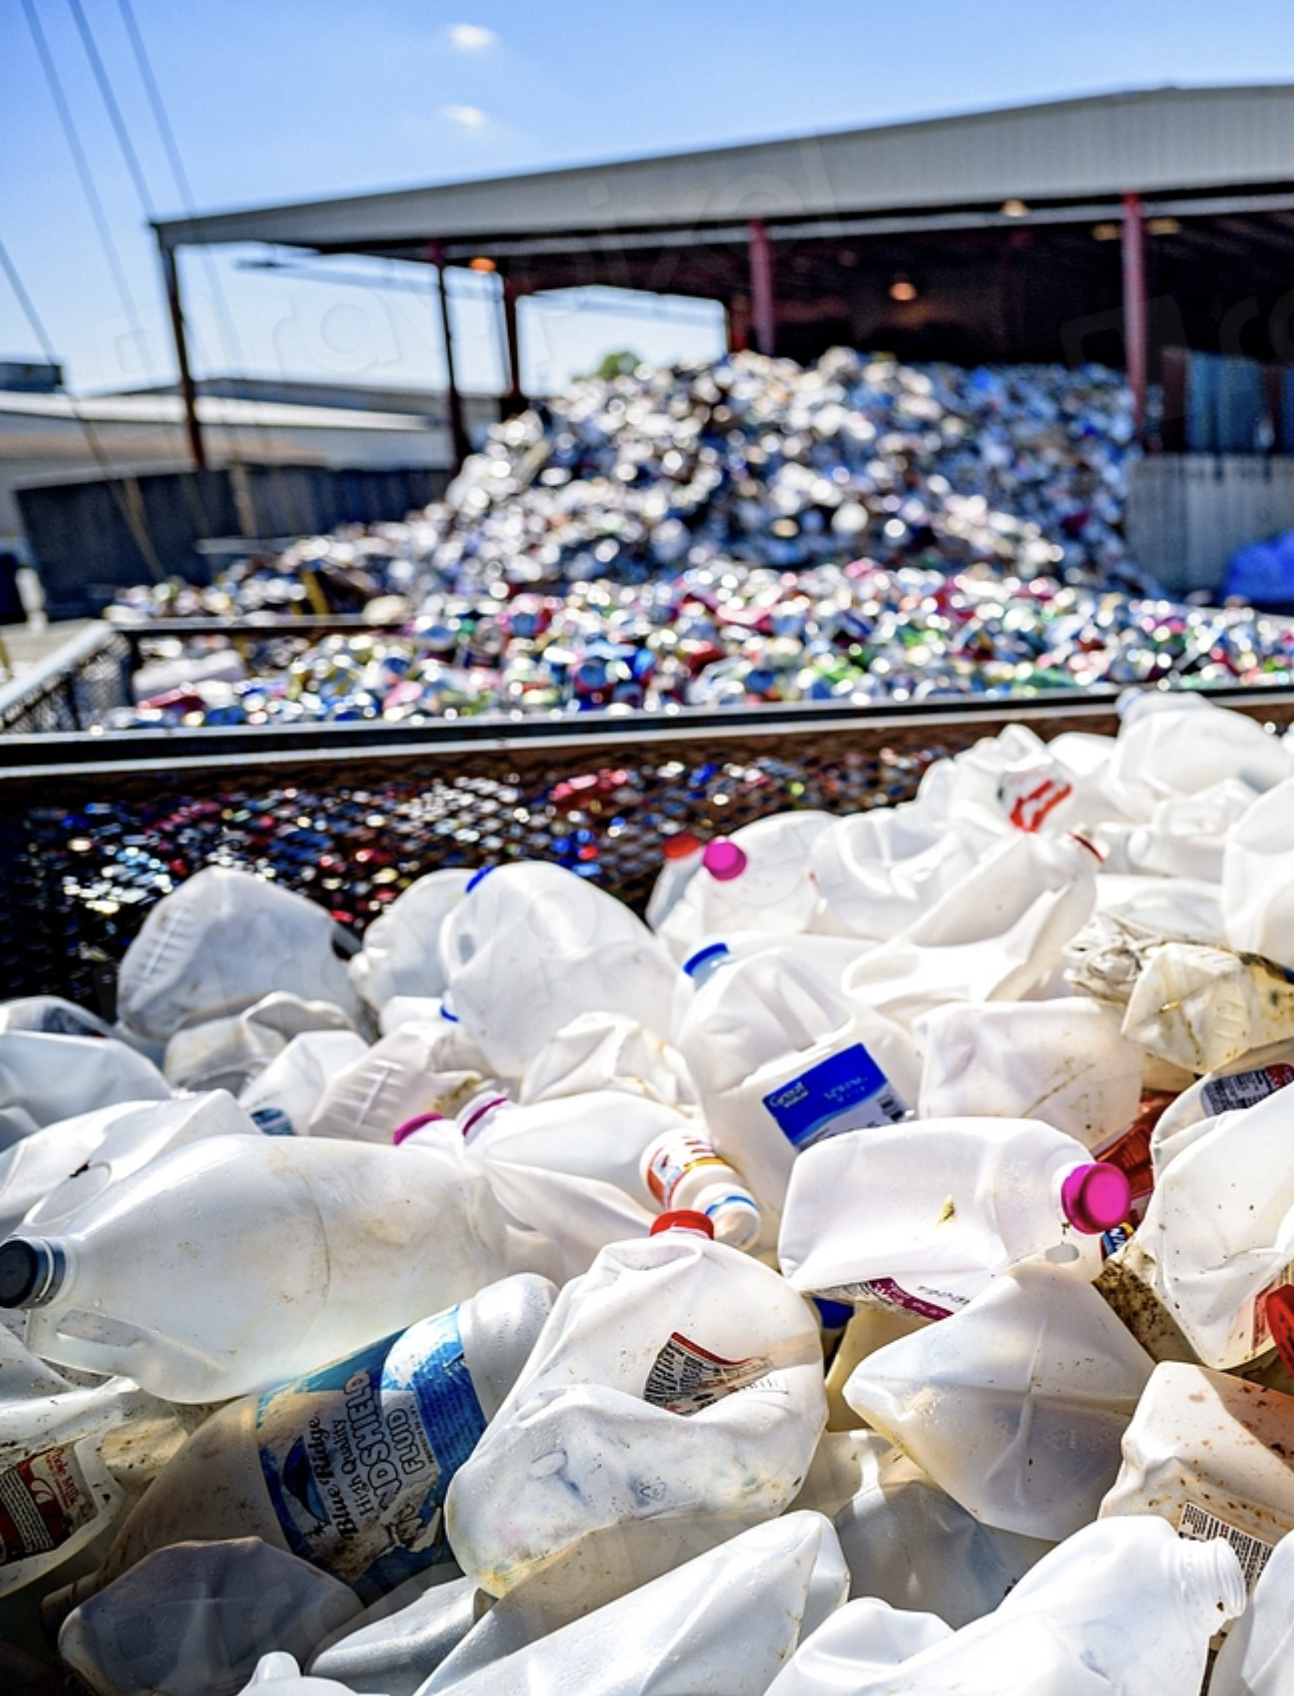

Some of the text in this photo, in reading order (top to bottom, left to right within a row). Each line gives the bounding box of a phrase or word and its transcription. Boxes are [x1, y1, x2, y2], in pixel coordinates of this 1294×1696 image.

[307, 1415, 359, 1541] Blue Ridge
[332, 1419, 375, 1517] High Quality
[386, 1407, 426, 1476] FLUID
